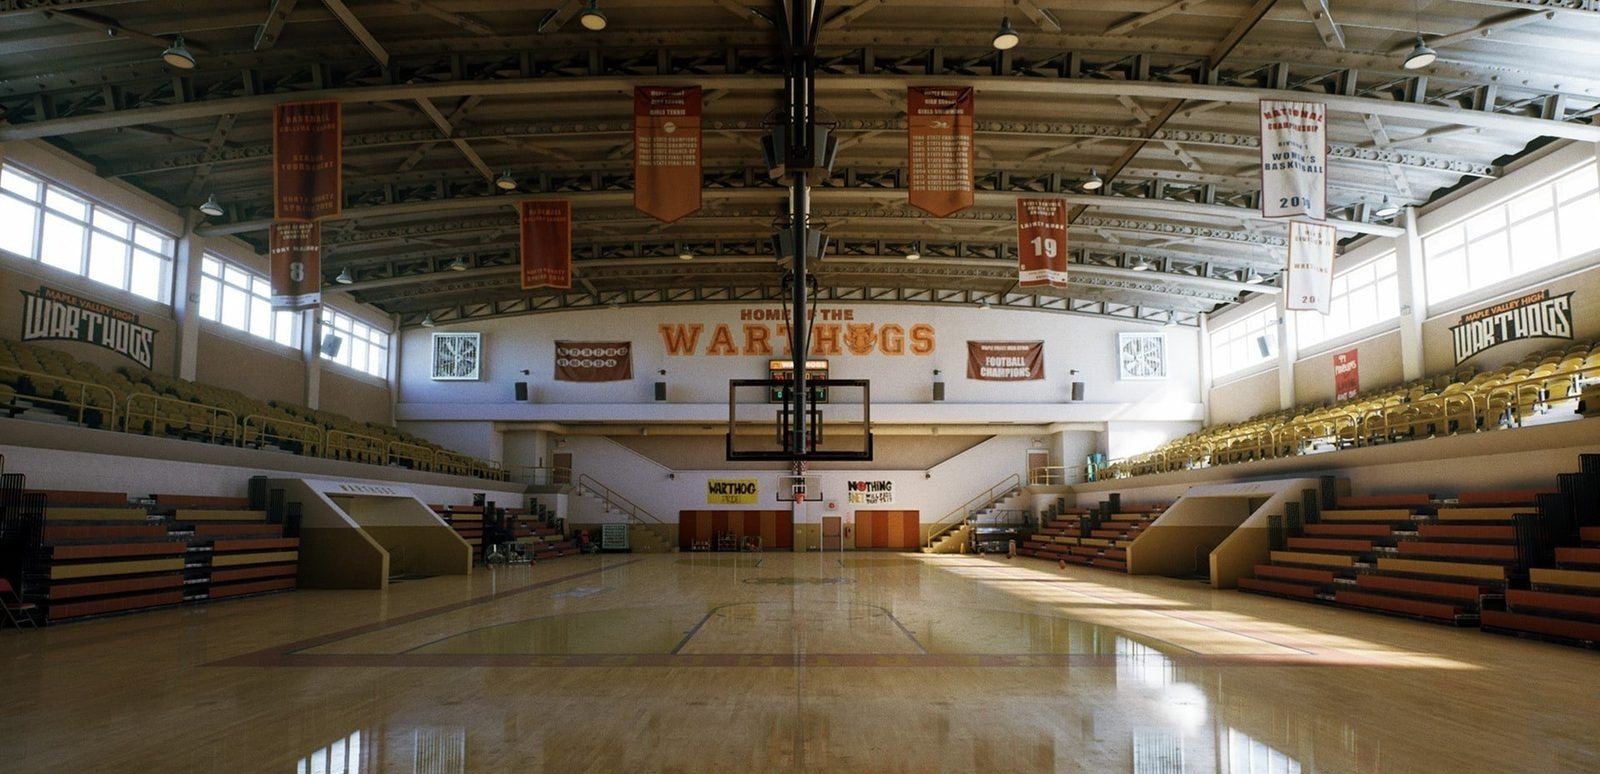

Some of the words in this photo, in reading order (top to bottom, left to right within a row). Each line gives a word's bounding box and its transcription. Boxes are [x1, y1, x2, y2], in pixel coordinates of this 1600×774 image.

[1263, 107, 1324, 122] NATIONAL
[1267, 121, 1319, 133] CHAMPIONSHIP
[1271, 151, 1317, 164] WOMEN'S
[1264, 161, 1324, 174] BASKETBALL
[1030, 236, 1058, 258] 19
[290, 261, 304, 282] 8
[46, 289, 78, 304] MAPLE
[79, 299, 111, 314] VALLEY
[111, 308, 134, 321] HIGH
[1465, 309, 1489, 322] MAPLE
[1490, 299, 1520, 315] VALLEY
[1521, 290, 1545, 306] HIGH
[740, 309, 793, 321] HOME
[821, 309, 854, 321] THE
[23, 295, 154, 369] WARTHOGS
[1453, 295, 1572, 365] WARTHOGS
[985, 356, 1026, 367] FOOTBALL
[980, 366, 1032, 378] CHAMPIONS
[708, 482, 756, 495] WARTHOG
[847, 481, 893, 492] NOTHING
